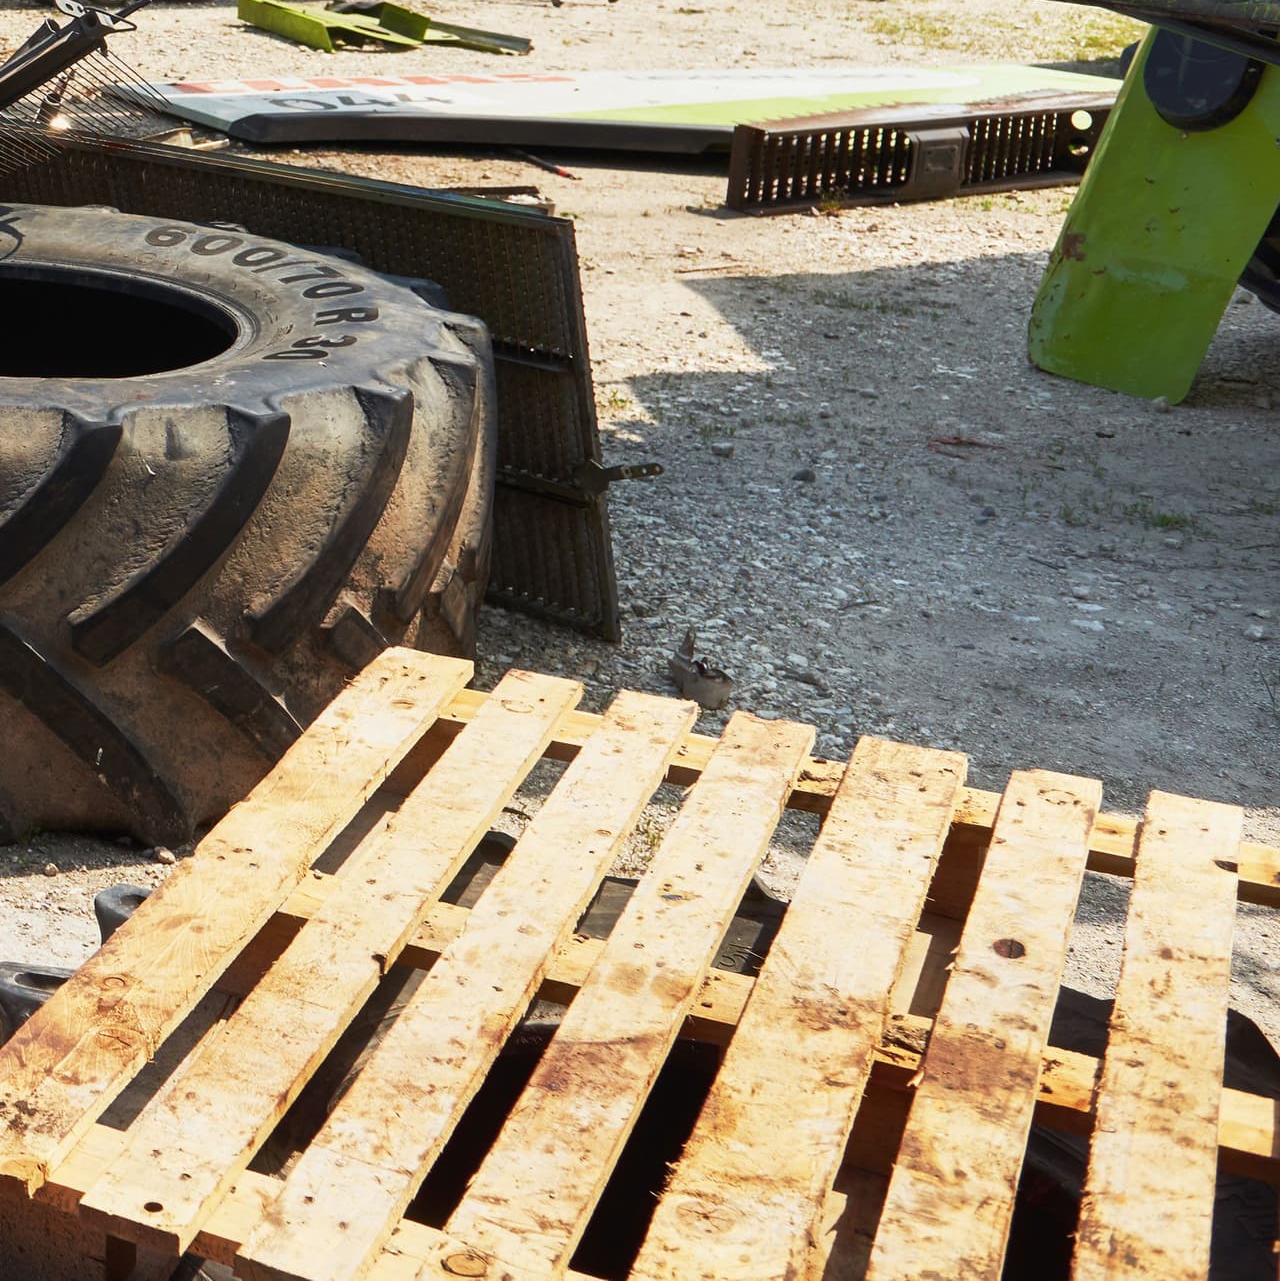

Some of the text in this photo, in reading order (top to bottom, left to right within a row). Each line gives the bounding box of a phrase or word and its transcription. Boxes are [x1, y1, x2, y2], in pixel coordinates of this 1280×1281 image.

[173, 73, 577, 94] CLAAS
[144, 224, 366, 299] 600/70
[313, 306, 380, 327] R
[261, 334, 358, 361] 30
